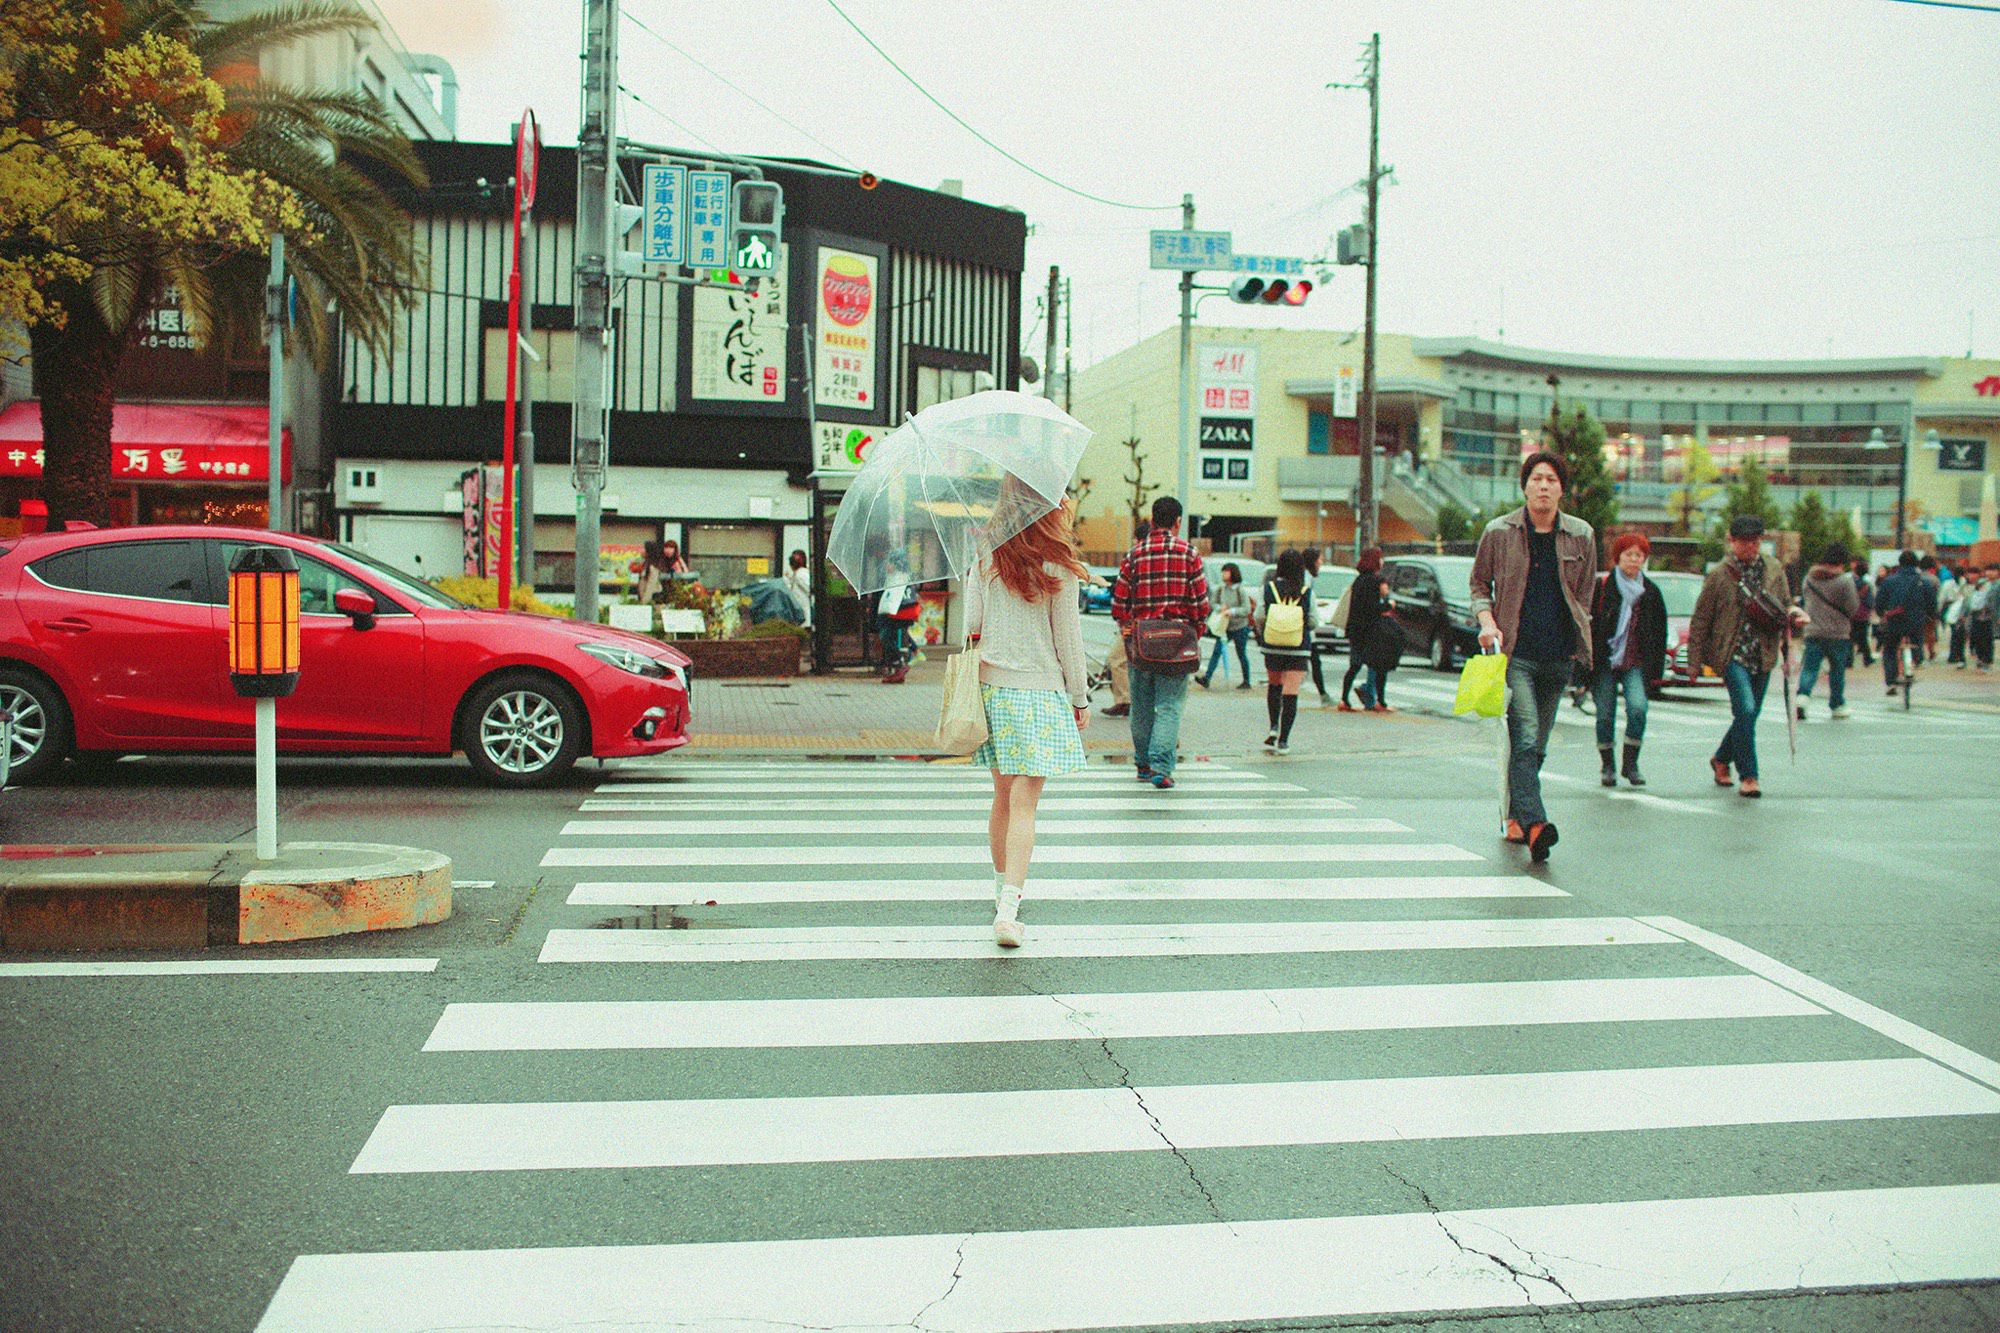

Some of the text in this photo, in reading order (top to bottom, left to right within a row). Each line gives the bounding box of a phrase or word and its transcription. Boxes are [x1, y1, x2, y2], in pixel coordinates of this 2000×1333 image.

[653, 171, 675, 258] 歩車分離式
[1202, 425, 1251, 442] ZARA
